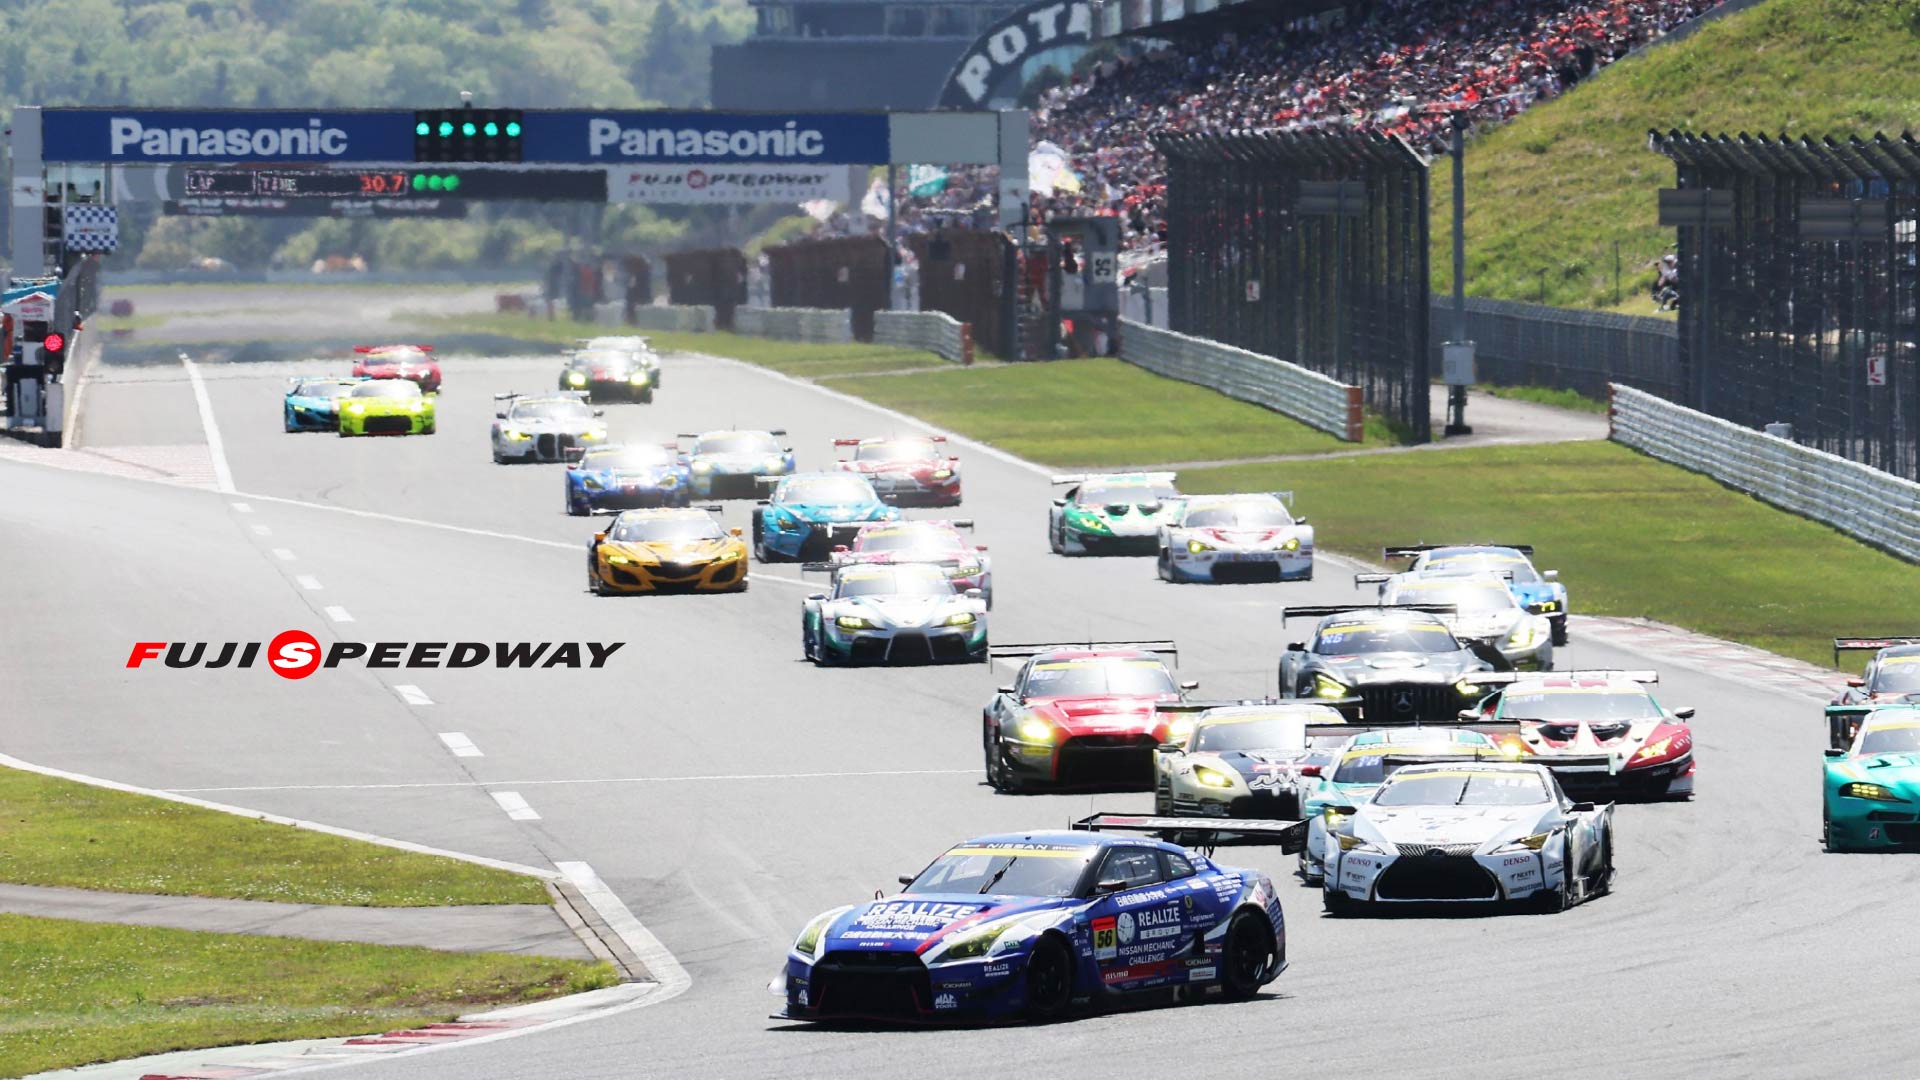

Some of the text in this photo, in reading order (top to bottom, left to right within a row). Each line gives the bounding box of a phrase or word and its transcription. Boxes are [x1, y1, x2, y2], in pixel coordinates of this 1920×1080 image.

[110, 118, 348, 155] Panasonic
[589, 118, 824, 156] Panasonic
[360, 175, 403, 192] 30.7
[1348, 857, 1371, 866] DENSO
[1503, 856, 1530, 866] DENSO
[871, 902, 977, 918] REALIZE
[1138, 907, 1181, 927] REALIZE
[1097, 930, 1113, 948] 56
[1119, 940, 1176, 956] NISSAN MECHANIC
[1128, 952, 1165, 966] CHALLENGE
[1105, 970, 1129, 980] nismo
